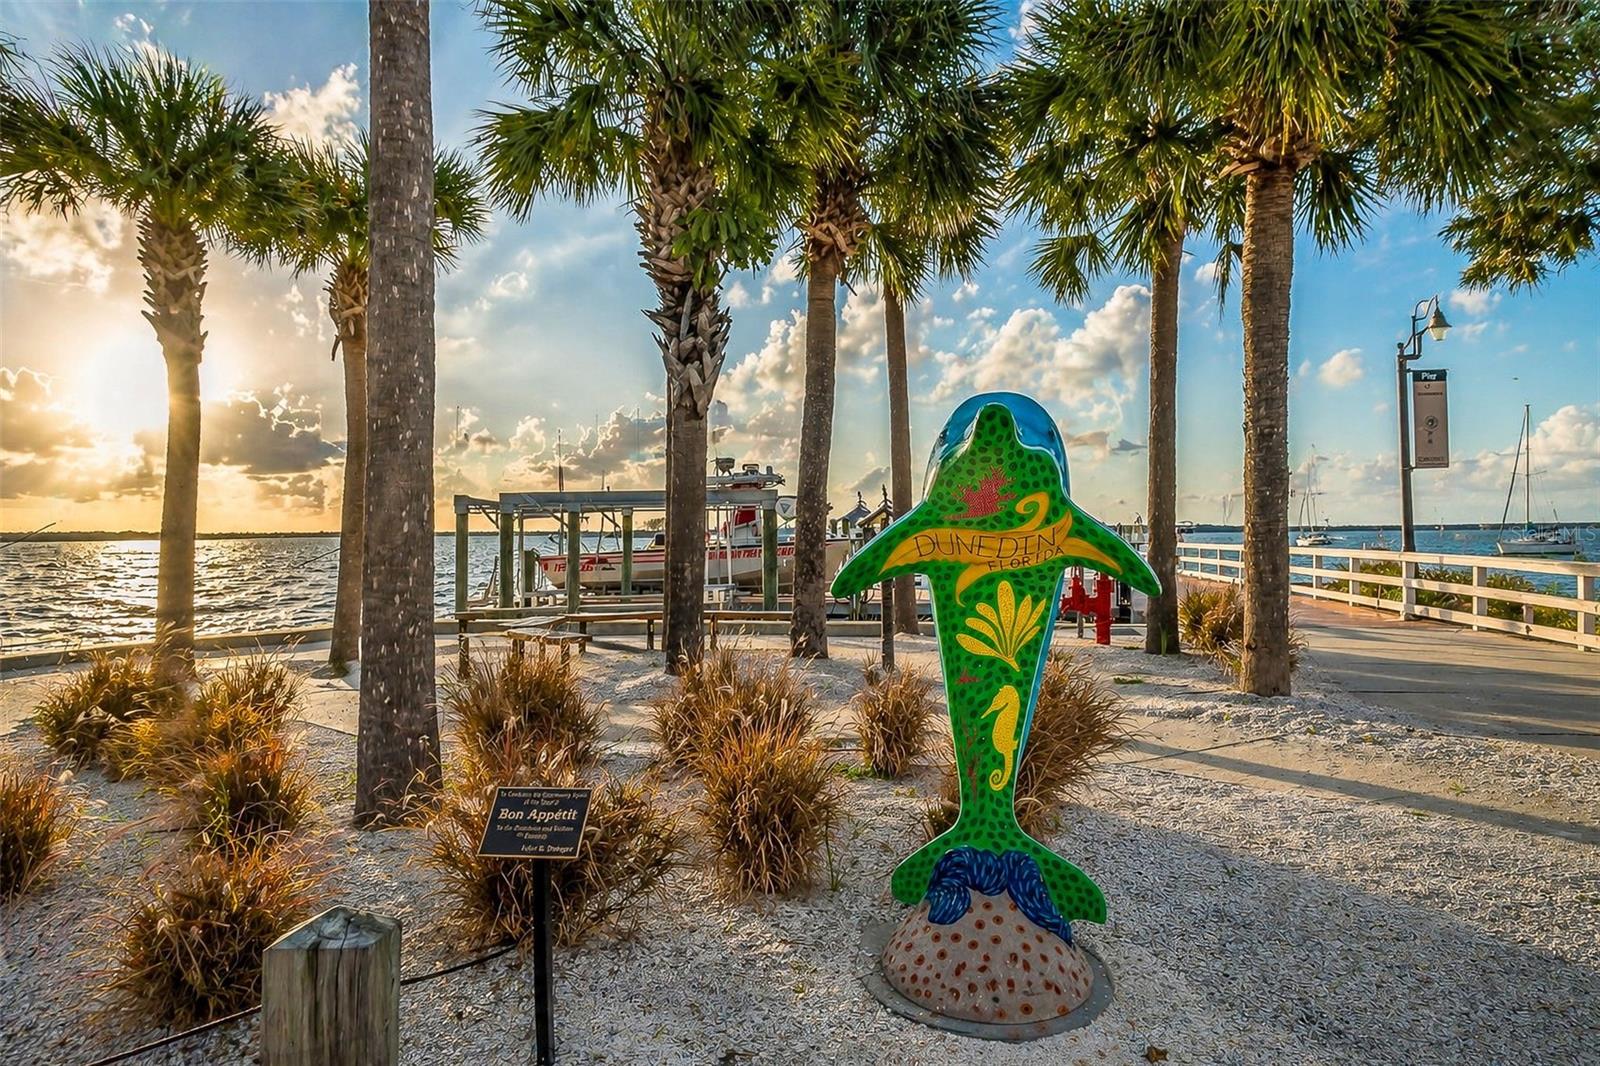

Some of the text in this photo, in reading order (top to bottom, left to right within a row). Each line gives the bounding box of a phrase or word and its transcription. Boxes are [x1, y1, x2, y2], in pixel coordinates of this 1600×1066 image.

[914, 527, 1056, 559] DUNEDIN
[987, 545, 1065, 571] FLORIDA
[498, 808, 578, 823] Bon Appétit
